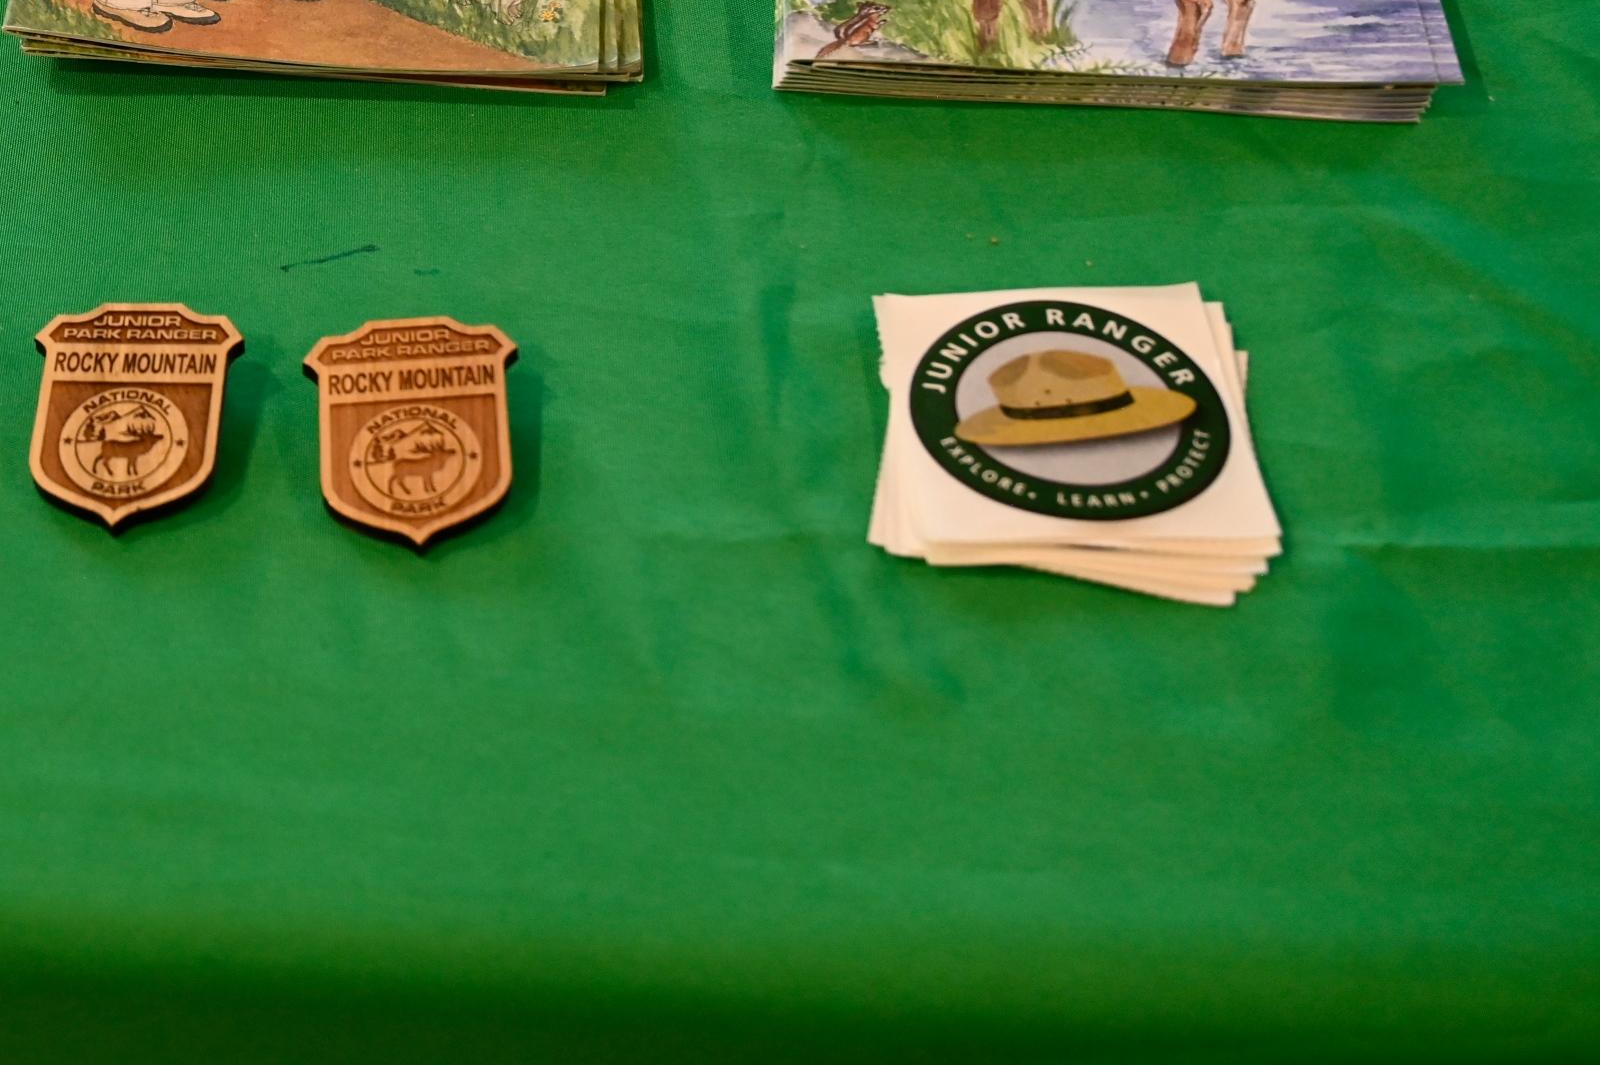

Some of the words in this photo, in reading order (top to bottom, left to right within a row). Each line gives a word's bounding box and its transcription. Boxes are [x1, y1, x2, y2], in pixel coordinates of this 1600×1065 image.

[93, 314, 182, 327] JUNIOR
[63, 327, 121, 339] PARK
[126, 328, 218, 340] RANGER
[359, 328, 451, 346] JUNIOR
[331, 346, 392, 361] PARK
[396, 339, 491, 357] RANGER
[921, 311, 1027, 395] JUNIOR
[1045, 307, 1196, 388] RANGER
[53, 351, 119, 373] ROCKY
[121, 352, 218, 375] MOUNTAIN
[328, 370, 393, 396] ROCKY
[398, 364, 496, 391] MOUNTAIN
[82, 389, 172, 416] NATIONAL
[366, 405, 459, 435] NATIONAL
[1056, 490, 1137, 509] LEARN
[1155, 427, 1212, 495] PROTECT
[90, 480, 146, 496] PARK
[389, 496, 447, 514] PARK
